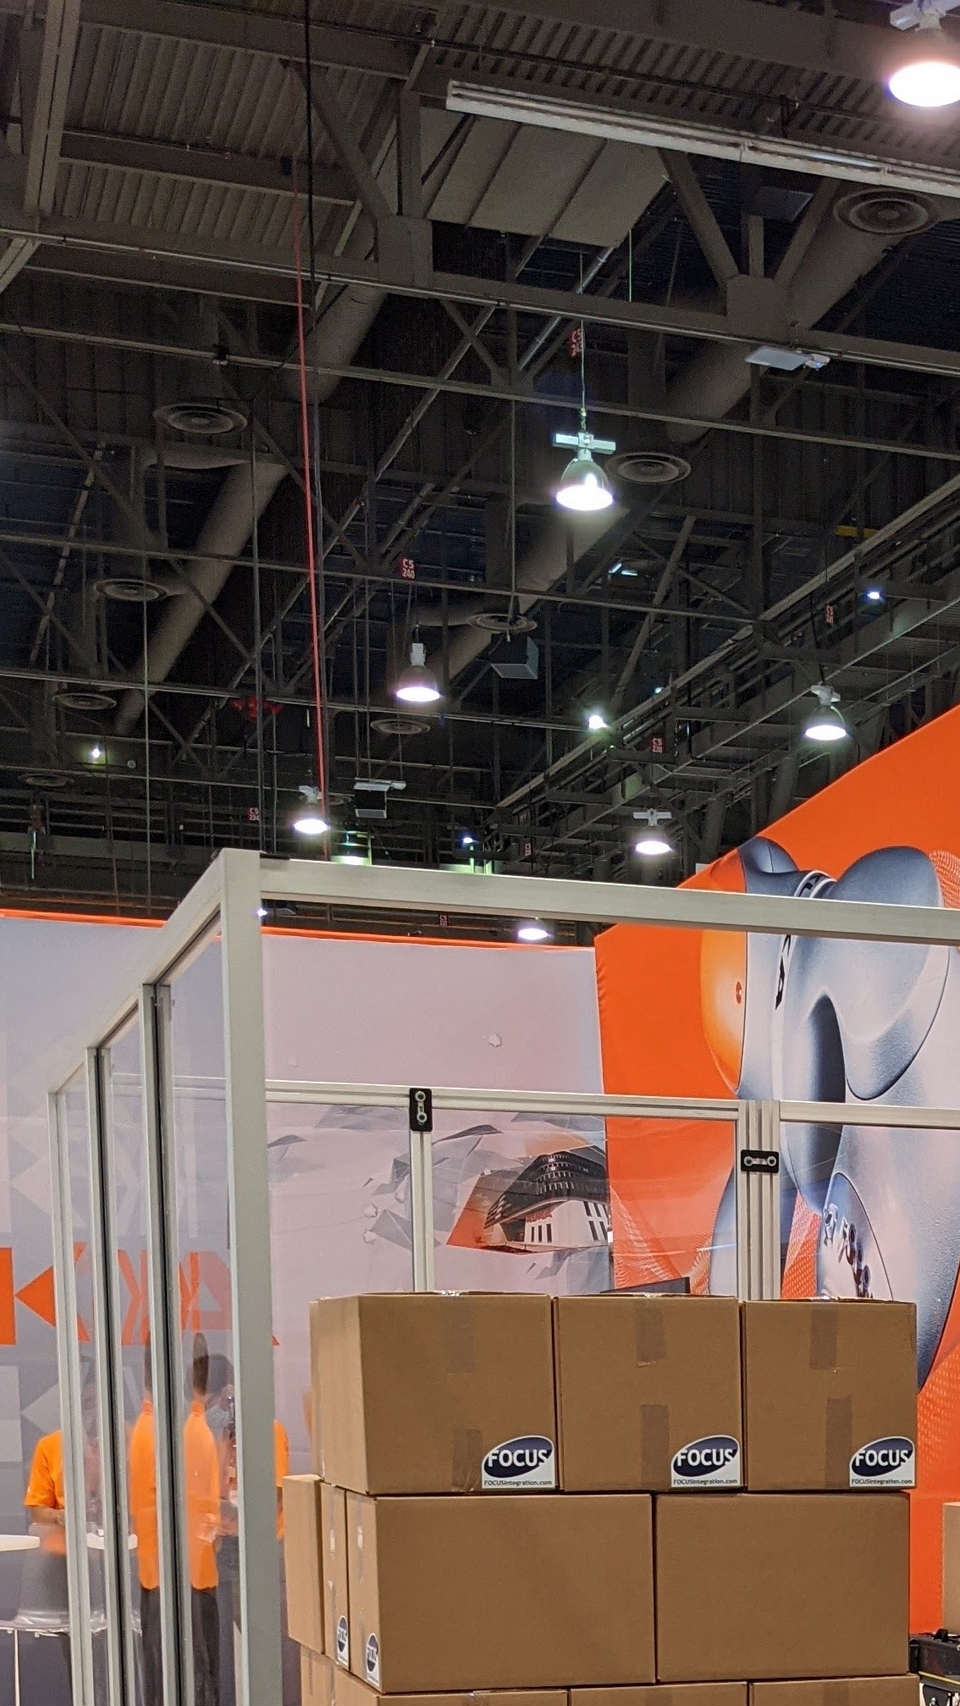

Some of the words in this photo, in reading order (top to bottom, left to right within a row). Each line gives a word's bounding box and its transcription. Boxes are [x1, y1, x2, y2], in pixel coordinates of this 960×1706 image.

[402, 568, 416, 579] 240
[487, 1449, 549, 1468] FOCUS
[676, 1448, 734, 1467] FOCUS
[855, 1449, 910, 1468] FOCUS
